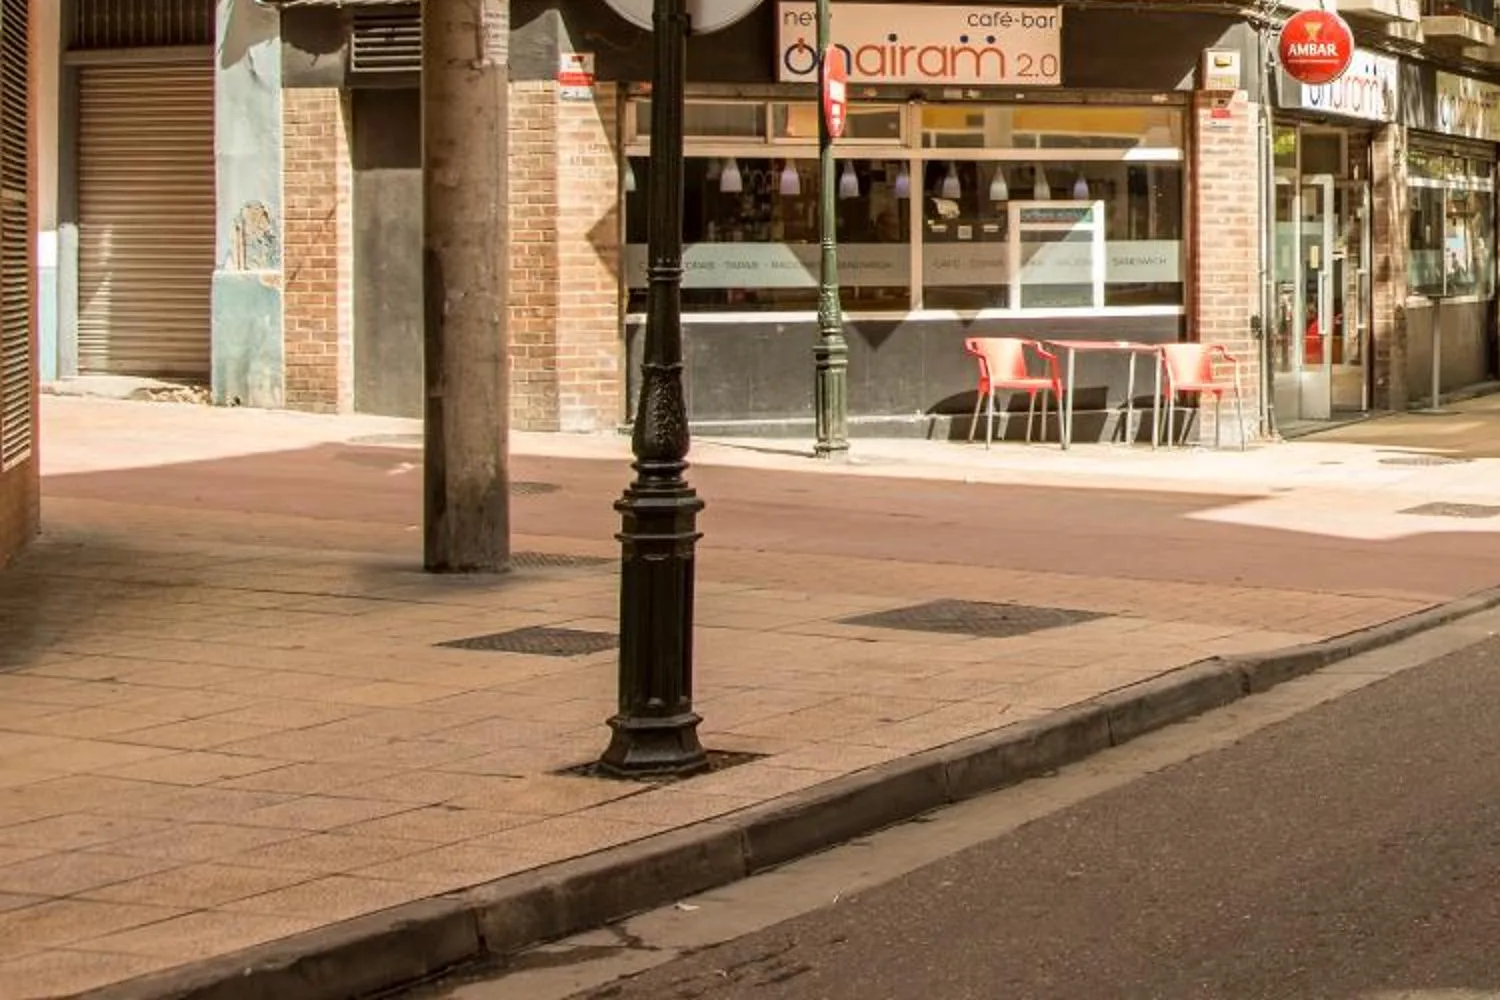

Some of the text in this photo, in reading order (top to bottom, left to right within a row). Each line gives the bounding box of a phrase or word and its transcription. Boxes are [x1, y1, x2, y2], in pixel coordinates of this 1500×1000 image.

[967, 11, 1057, 29] café-bar
[1287, 42, 1339, 57] AMBAR
[1016, 53, 1058, 78] 2.0
